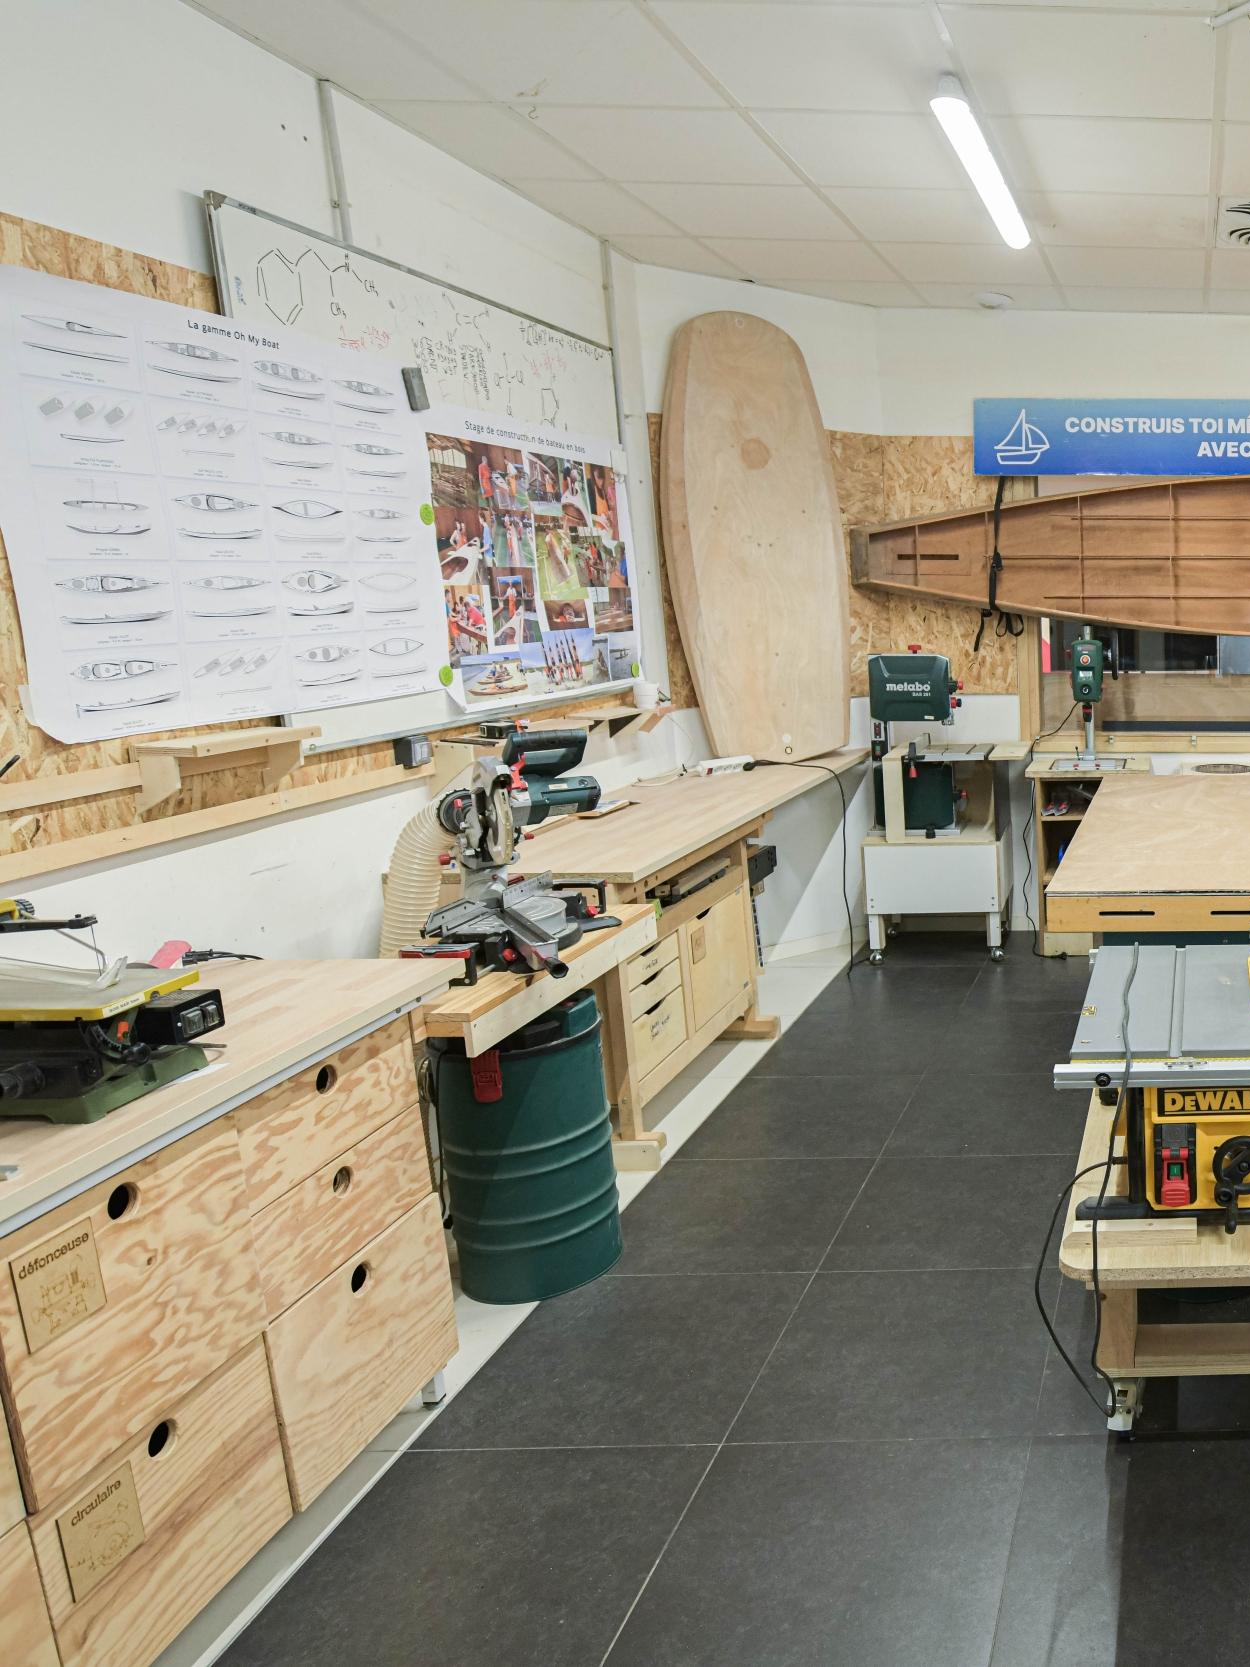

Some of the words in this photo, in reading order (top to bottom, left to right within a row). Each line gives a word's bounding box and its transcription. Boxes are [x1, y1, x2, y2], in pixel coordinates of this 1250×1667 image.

[188, 320, 199, 330] La
[202, 324, 232, 338] gamme
[234, 331, 246, 341] Oh
[248, 334, 260, 346] My
[262, 338, 280, 350] Boat
[464, 420, 484, 434] Stage
[486, 426, 494, 435] de
[1064, 416, 1185, 435] CONSTRUIS
[1189, 416, 1224, 434] TOI
[886, 682, 930, 692] metabo
[18, 1232, 89, 1280] défonceuse
[71, 1480, 122, 1527] circulaire
